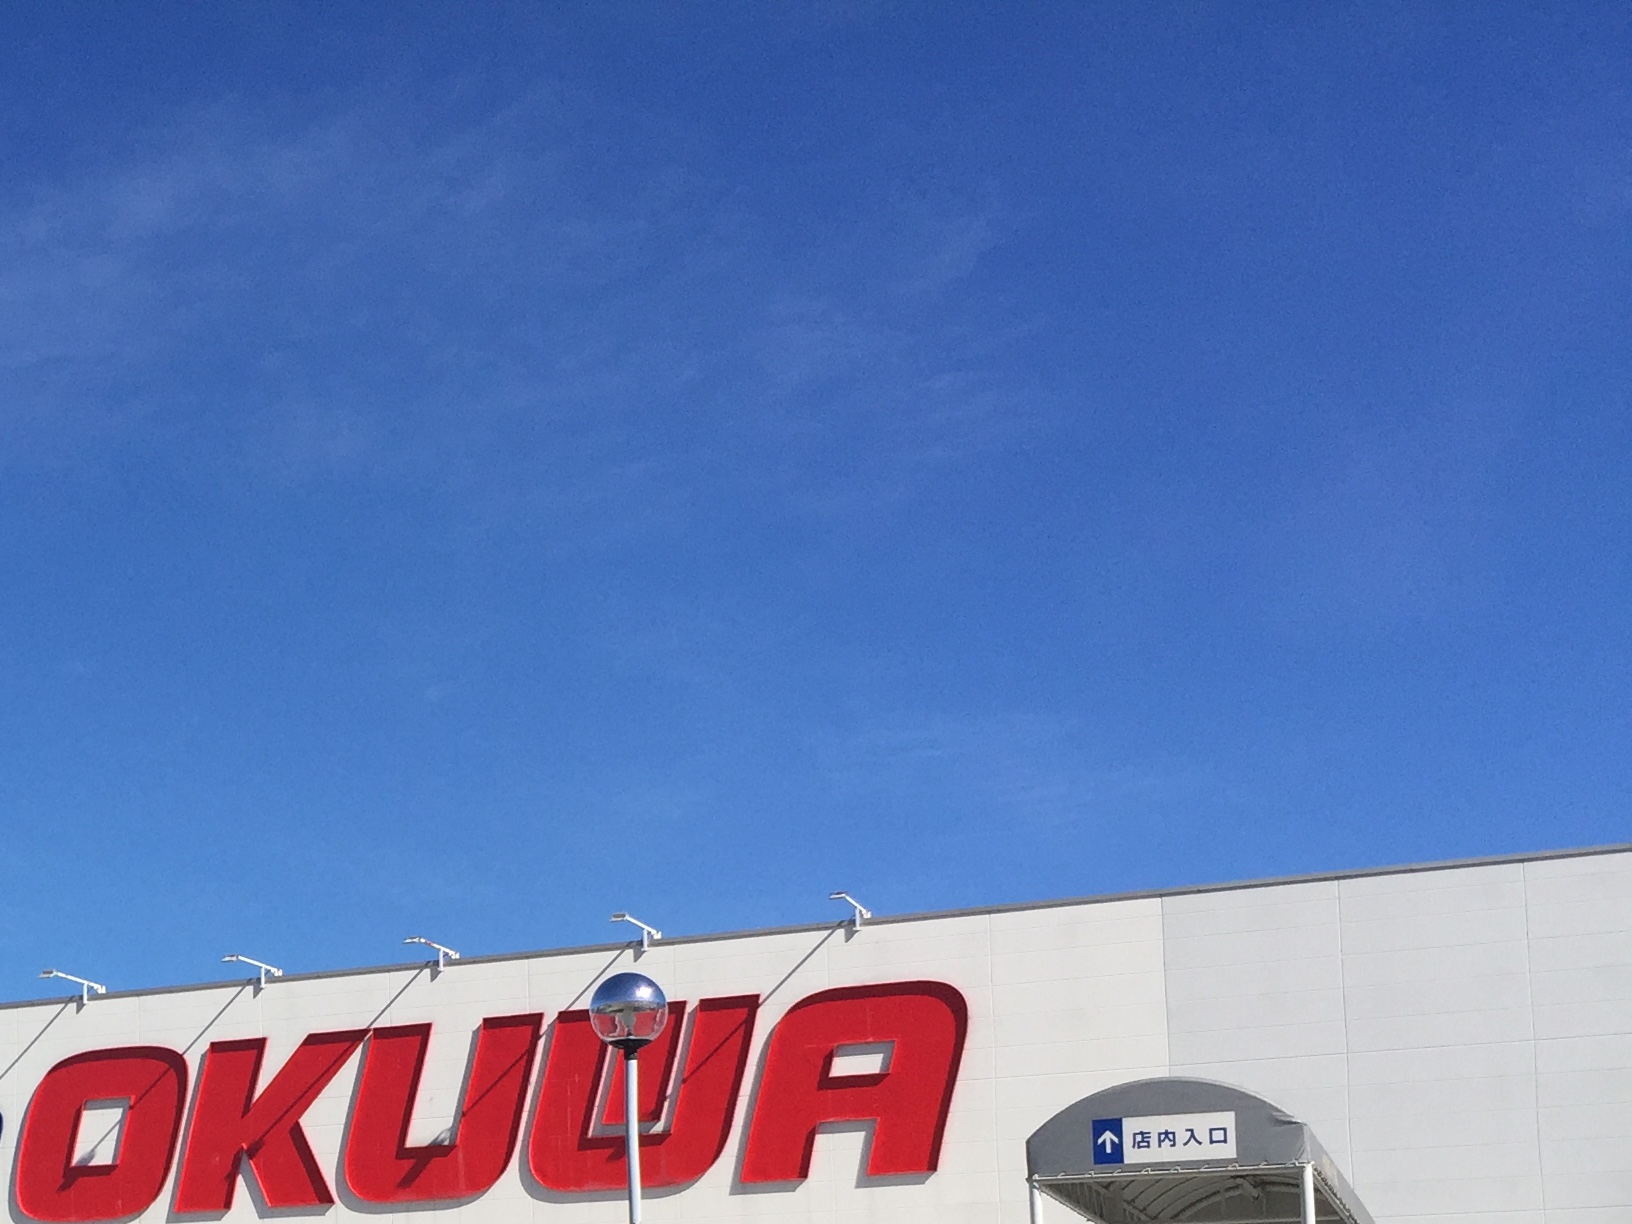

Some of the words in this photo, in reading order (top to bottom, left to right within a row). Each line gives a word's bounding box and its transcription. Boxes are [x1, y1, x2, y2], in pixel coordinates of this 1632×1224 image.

[17, 980, 968, 1223] OKUWA
[1132, 1127, 1228, 1149] 店内入口
